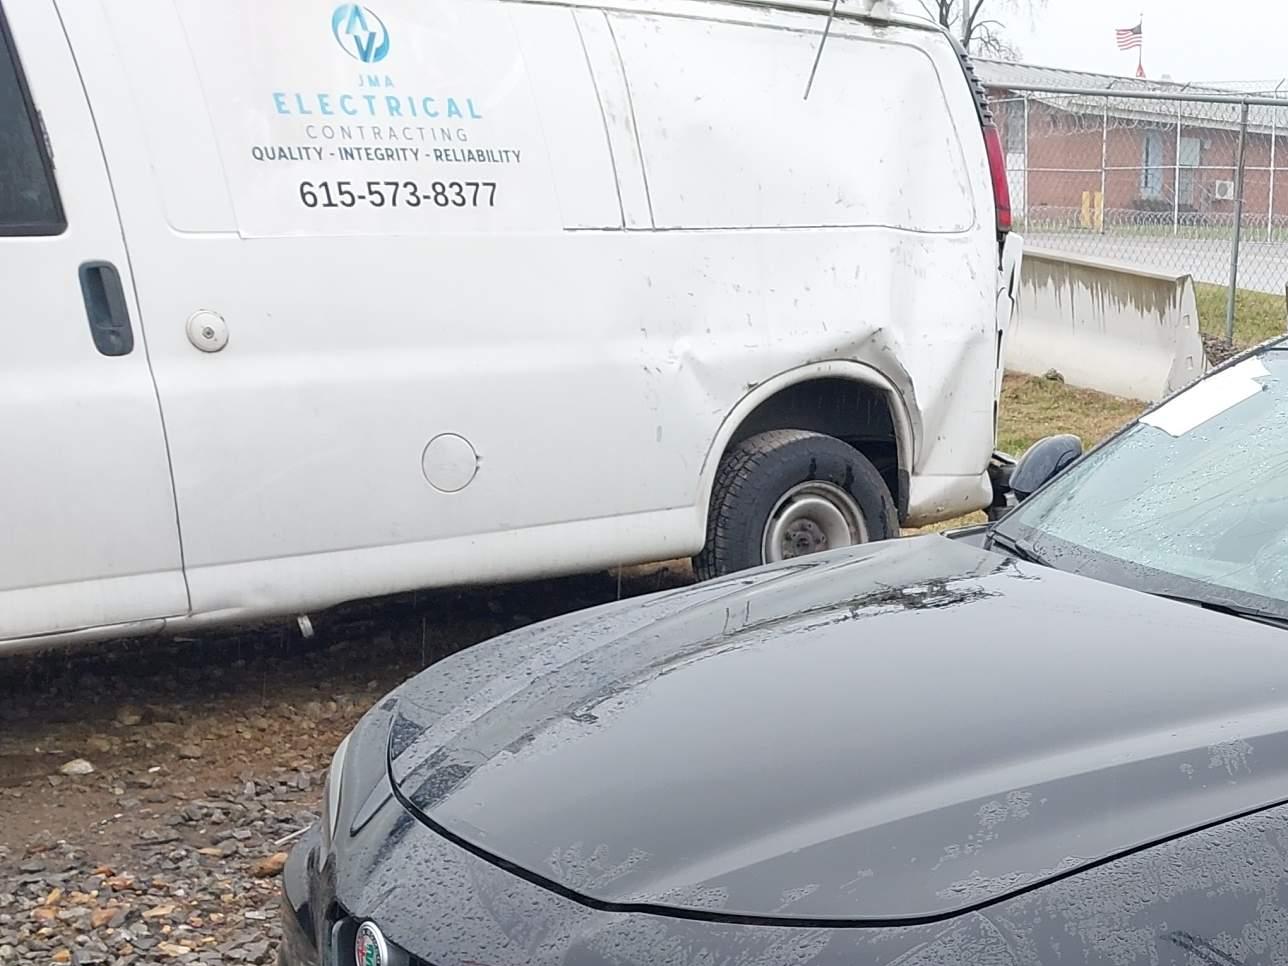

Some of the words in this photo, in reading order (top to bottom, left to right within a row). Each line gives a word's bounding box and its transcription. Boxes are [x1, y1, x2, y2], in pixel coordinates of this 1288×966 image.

[357, 74, 395, 88] JMA
[272, 92, 483, 119] ELECTRICAL
[305, 124, 468, 143] CONTRACTING
[251, 145, 324, 161] QUALITY
[338, 146, 420, 162] INTEGRITY
[434, 148, 521, 163] RELIABILITY
[299, 180, 497, 208] 615-573-8377
